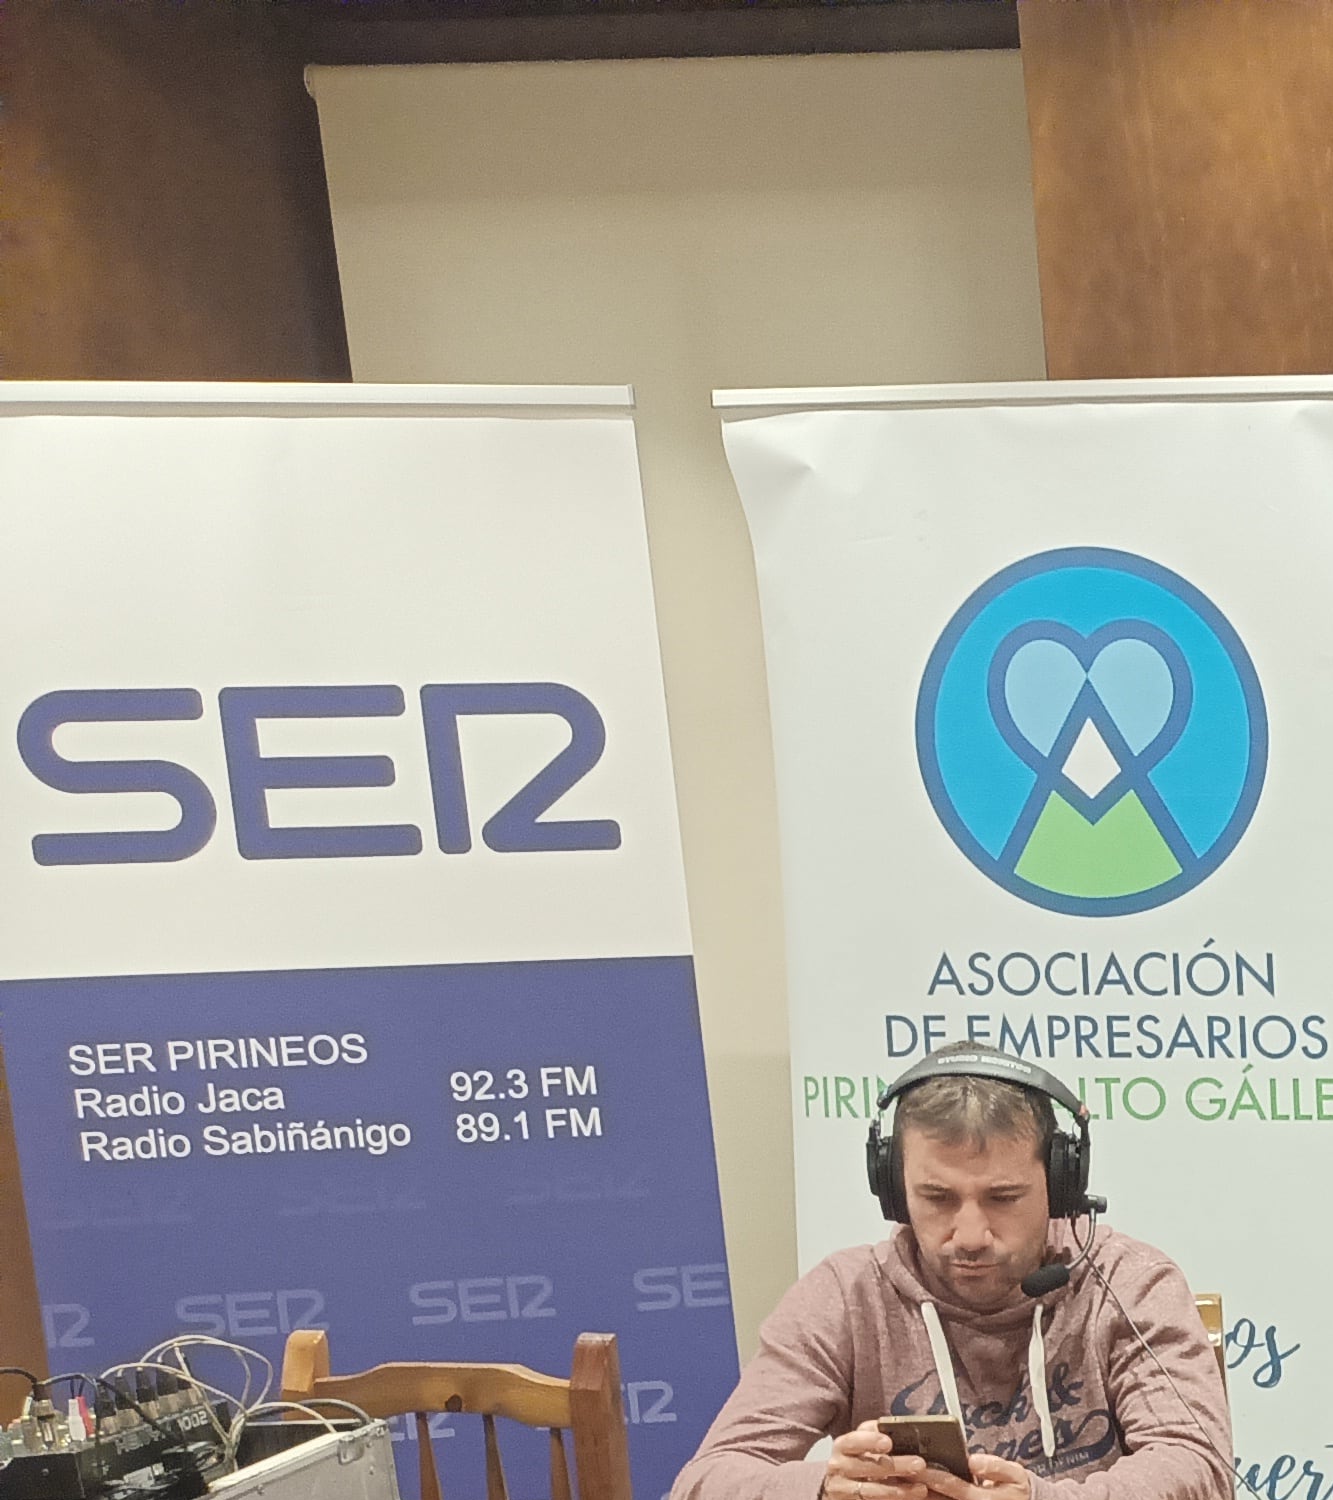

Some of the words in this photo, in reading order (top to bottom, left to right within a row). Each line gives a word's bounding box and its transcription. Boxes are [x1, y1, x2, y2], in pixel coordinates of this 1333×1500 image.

[17, 682, 622, 866] SER
[926, 938, 1277, 998] ASOCIACIÓN
[68, 1041, 156, 1077] SER
[167, 1033, 368, 1073] PIRINEOS
[886, 1014, 947, 1059] DE
[968, 1014, 1330, 1060] EMPRESARIOS
[74, 1085, 186, 1120] Radio
[196, 1082, 286, 1115] Jaca
[449, 1068, 529, 1103] 92.3
[540, 1064, 599, 1098] FM
[804, 1075, 890, 1118] PIRI
[1060, 1077, 1167, 1121] LTO
[80, 1128, 192, 1163] Radio
[202, 1117, 412, 1157] Sabiñánigo
[455, 1108, 530, 1143] 89.1
[544, 1106, 603, 1139] FM
[174, 1288, 330, 1338] SER
[409, 1274, 557, 1326] SER
